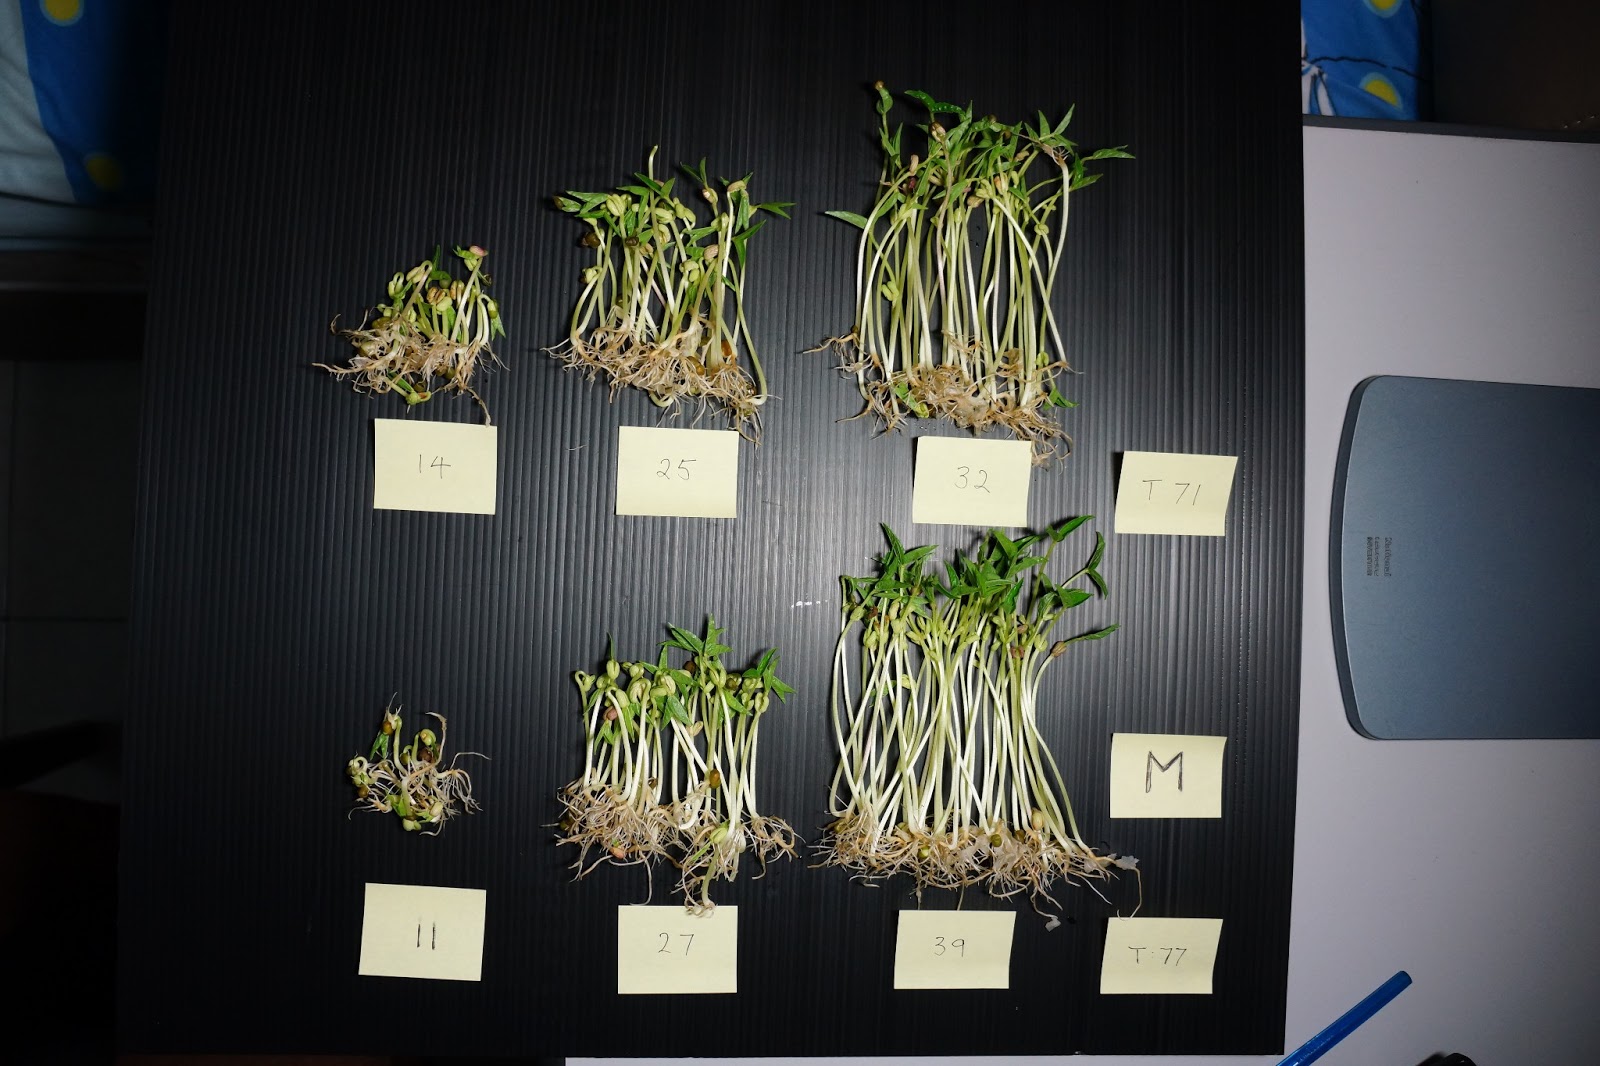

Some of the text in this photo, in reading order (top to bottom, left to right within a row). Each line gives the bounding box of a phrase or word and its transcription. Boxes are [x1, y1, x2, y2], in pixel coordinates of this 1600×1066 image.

[418, 453, 452, 480] 14
[655, 458, 697, 481] 25
[954, 465, 991, 494] 32
[1142, 479, 1202, 506] T 71
[1145, 750, 1184, 794] M
[416, 918, 437, 951] 11
[657, 932, 695, 957] 27
[934, 936, 965, 958] 39
